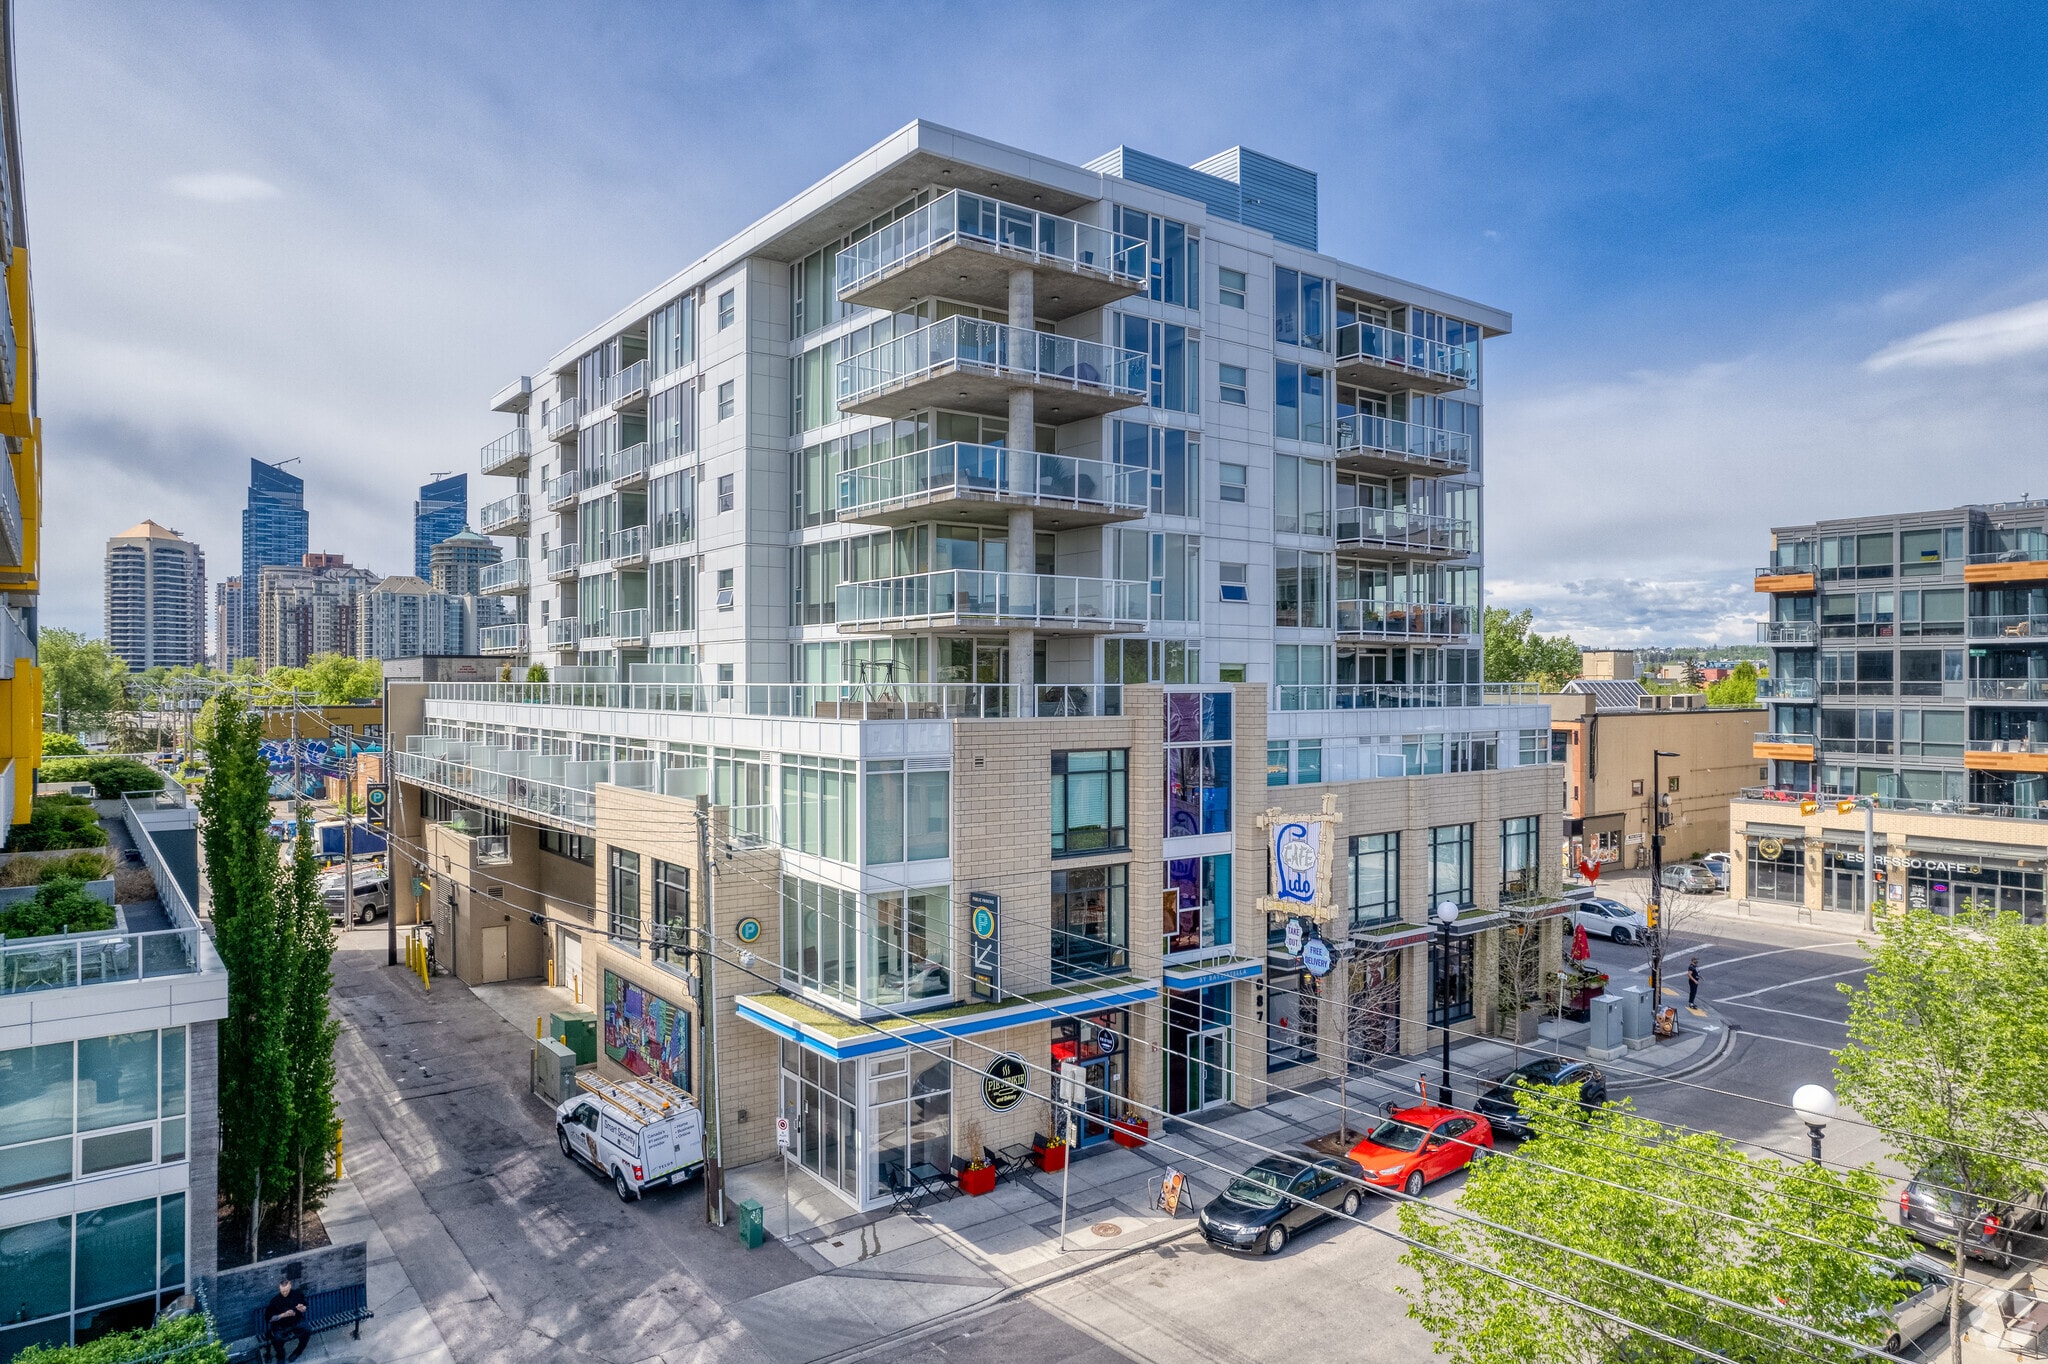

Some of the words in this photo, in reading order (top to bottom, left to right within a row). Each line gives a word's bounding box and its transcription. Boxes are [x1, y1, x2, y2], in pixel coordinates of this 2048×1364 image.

[374, 793, 383, 802] P
[1277, 824, 1315, 902] Lido
[1847, 852, 1922, 869] ESRESSO
[1925, 860, 1967, 874] CAFE
[978, 912, 988, 932] P
[745, 923, 756, 937] P
[1288, 926, 1300, 937] TAKE
[1288, 938, 1299, 947] OUT
[1200, 943, 1248, 970] LIDO
[1310, 945, 1323, 957] FREE
[1305, 956, 1328, 968] DELIVERY
[1208, 969, 1248, 981] BATTELLA
[604, 1119, 618, 1134] Smart
[618, 1128, 636, 1147] Security
[647, 1130, 666, 1139] Canada's
[658, 1161, 674, 1170] TELUS
